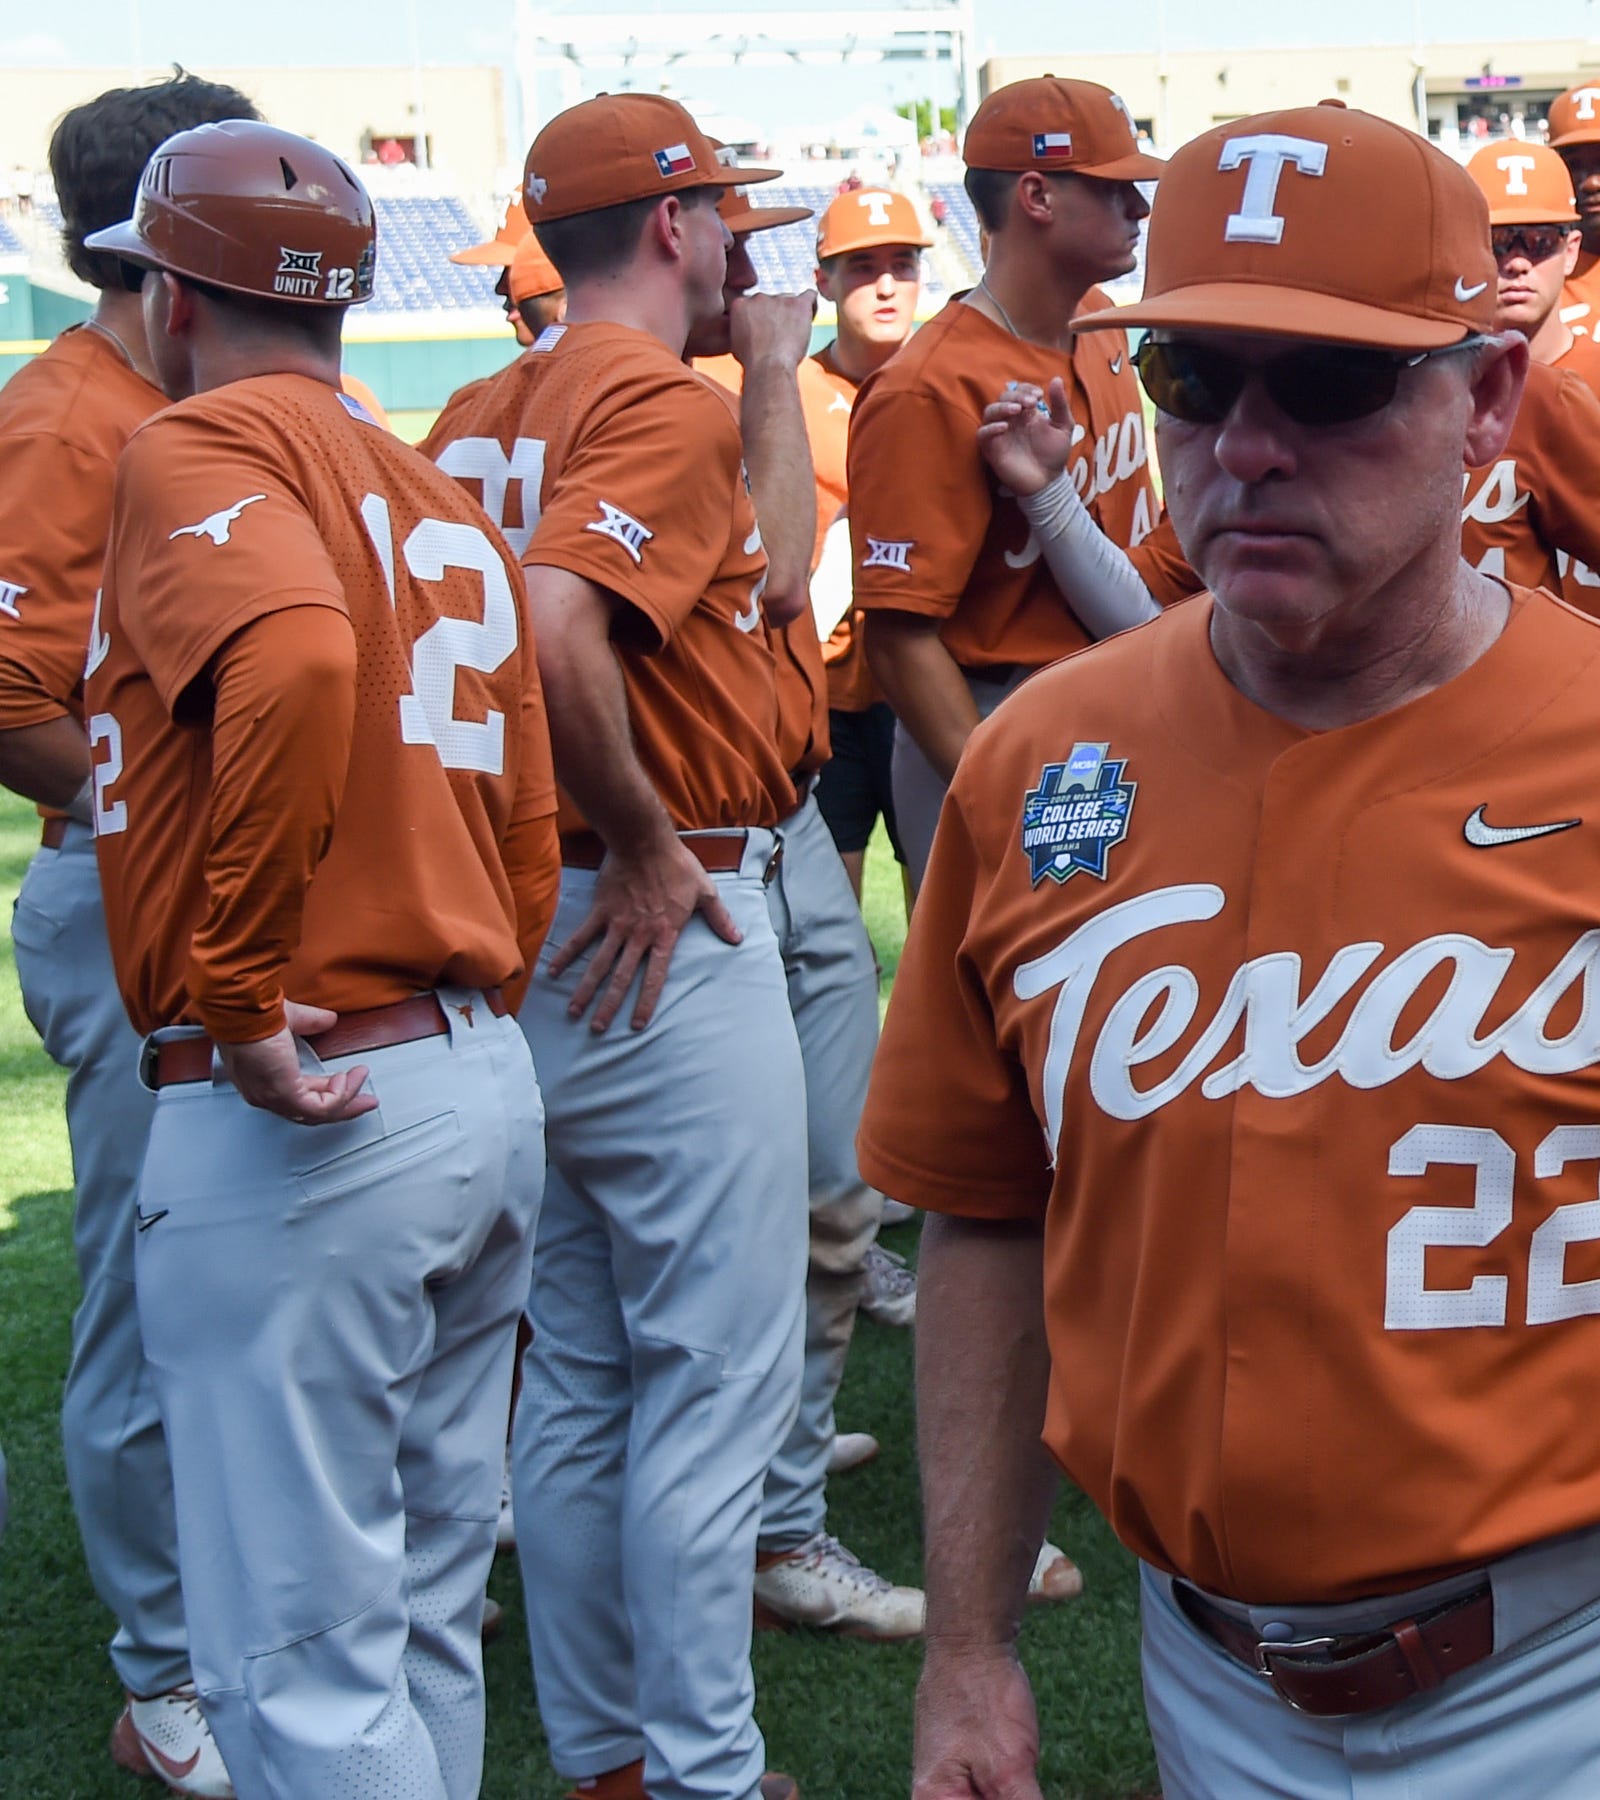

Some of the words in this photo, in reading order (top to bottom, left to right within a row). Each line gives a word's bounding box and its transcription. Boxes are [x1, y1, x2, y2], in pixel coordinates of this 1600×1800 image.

[1218, 134, 1329, 245] T
[1496, 154, 1536, 196] T
[858, 192, 894, 226] T
[274, 275, 319, 297] UNITY
[325, 266, 355, 300] 12
[1041, 800, 1104, 825] COLLEGE
[1024, 825, 1067, 849] WORLD
[1066, 818, 1122, 841] SERIES
[1051, 842, 1081, 854] OMAHA
